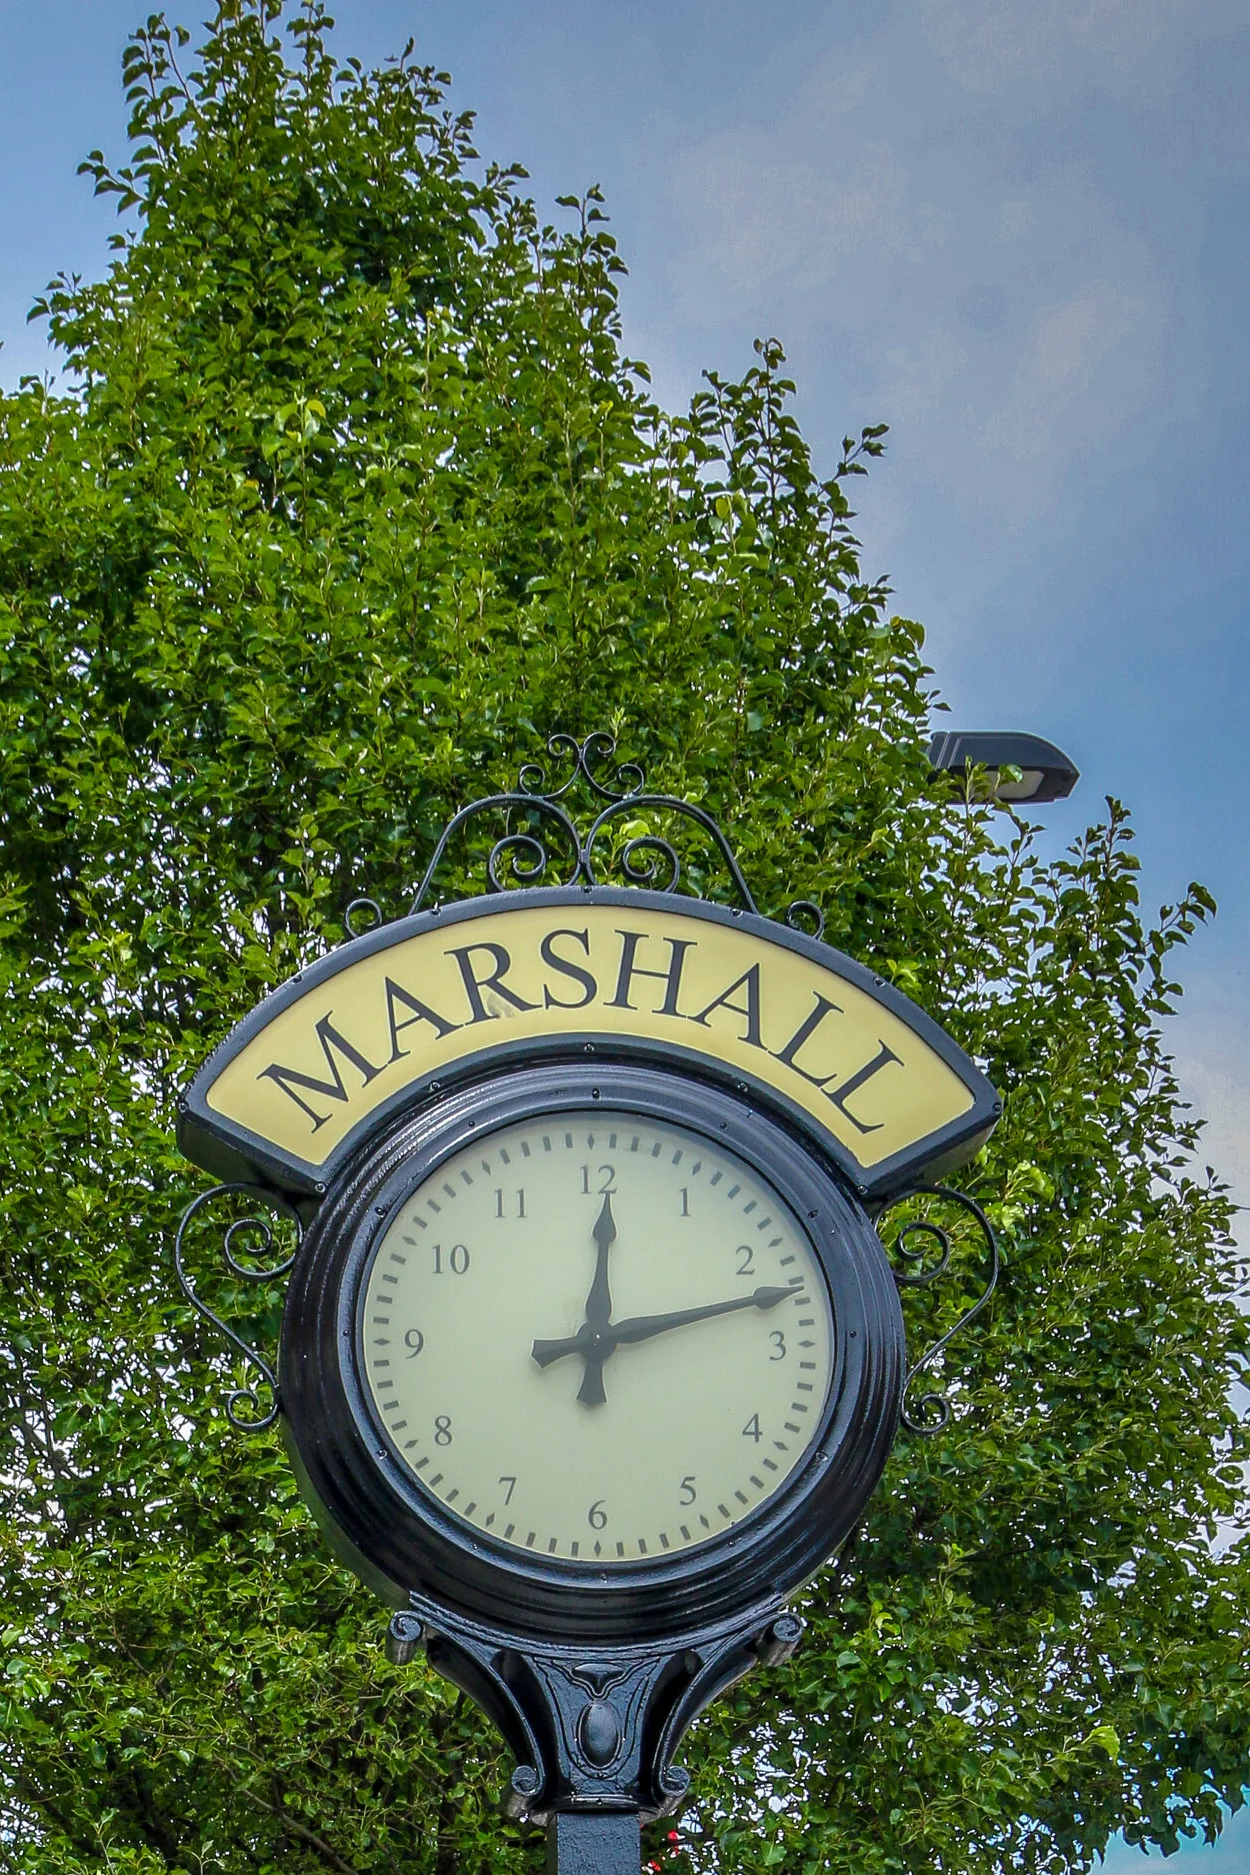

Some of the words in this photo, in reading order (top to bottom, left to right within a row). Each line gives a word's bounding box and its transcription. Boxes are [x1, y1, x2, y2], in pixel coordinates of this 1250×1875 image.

[255, 929, 905, 1135] MARSHALL
[580, 1165, 618, 1194] 12
[494, 1189, 527, 1218] 11
[679, 1187, 691, 1216] 1
[432, 1244, 470, 1274] 10
[736, 1245, 756, 1276] 2
[404, 1329, 425, 1359] 9
[768, 1330, 787, 1361] 3
[434, 1415, 453, 1446] 8
[742, 1413, 763, 1443] 4
[498, 1476, 517, 1505] 7
[680, 1475, 696, 1506] 5
[588, 1500, 608, 1530] 6
